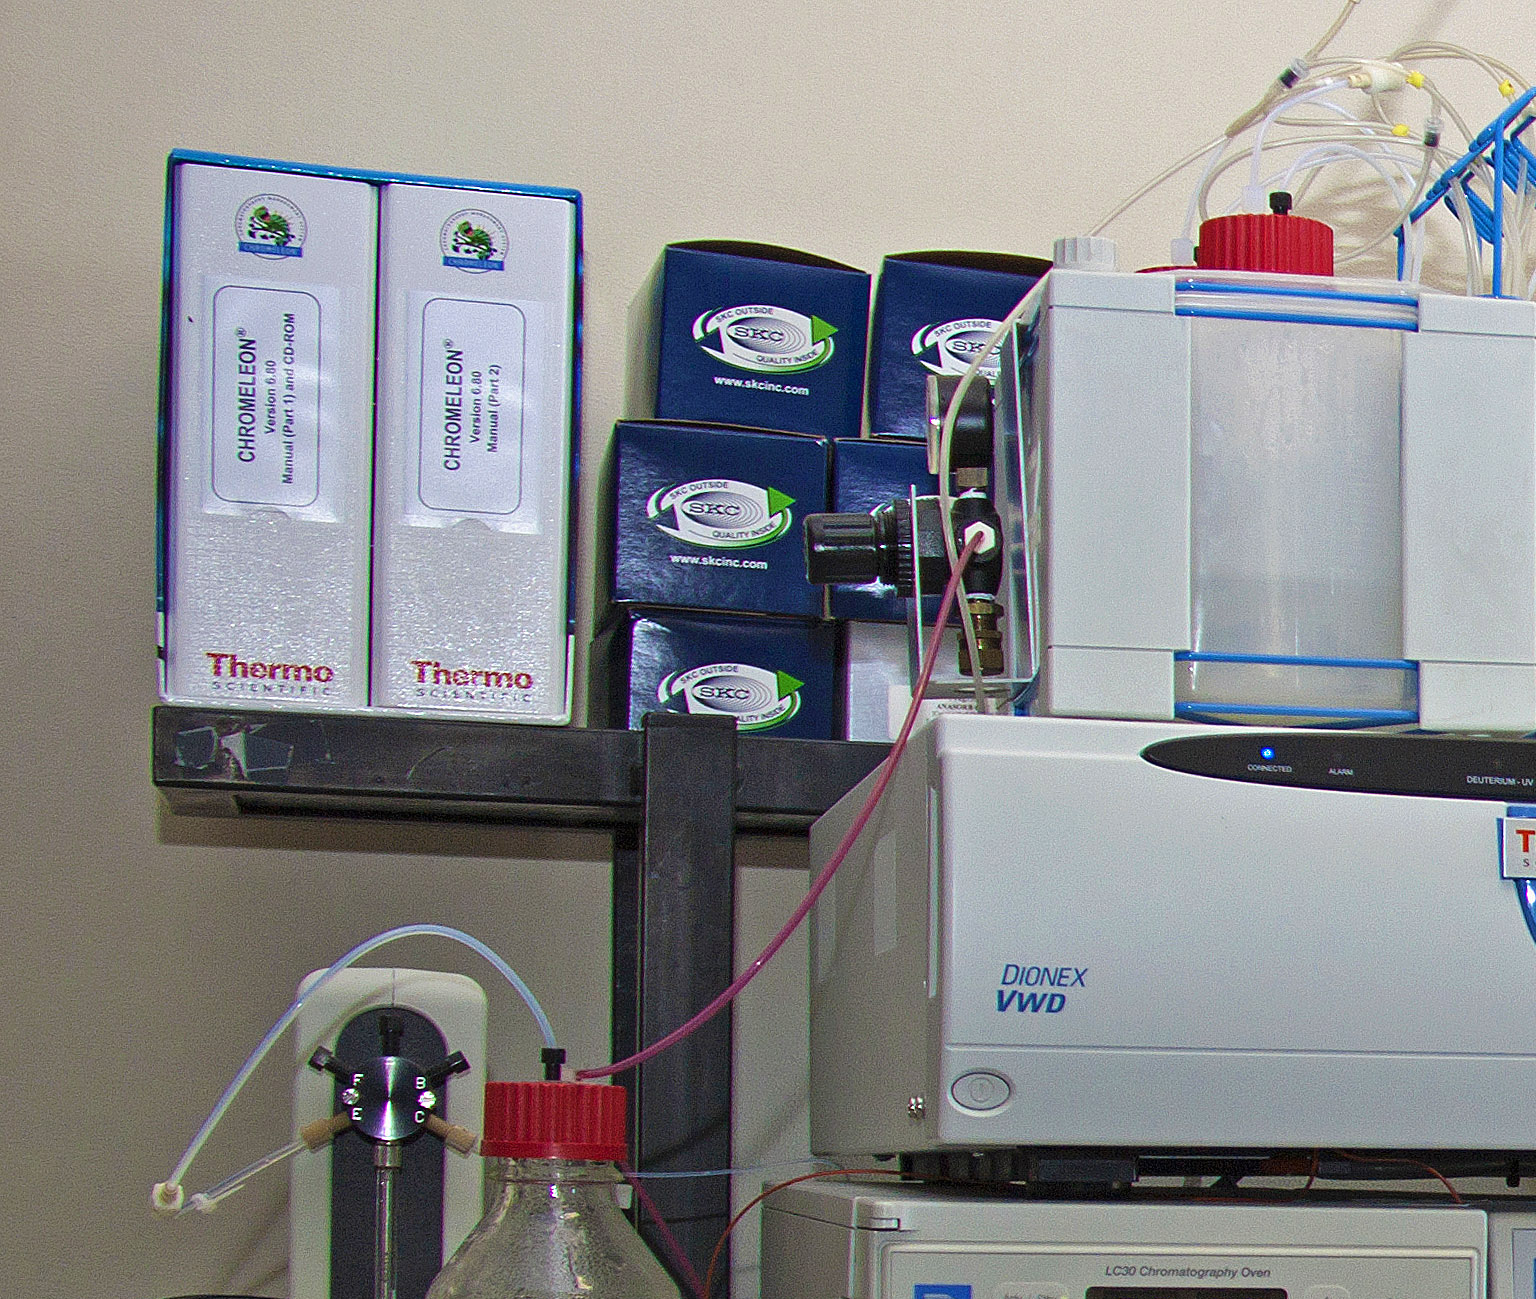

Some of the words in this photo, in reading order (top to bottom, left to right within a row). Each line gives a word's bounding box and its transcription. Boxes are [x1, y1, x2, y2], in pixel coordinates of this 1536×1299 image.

[736, 307, 774, 315] OUTSIDE
[283, 313, 295, 364] CD-ROM
[734, 326, 784, 342] SKC
[756, 354, 791, 364] QUALITY
[488, 365, 501, 376] 2)
[283, 369, 294, 391] and
[714, 376, 809, 395] www.skcinc.com
[283, 395, 296, 405] 1)
[488, 379, 501, 407] (Part
[264, 389, 276, 434] Version
[283, 409, 296, 437] (Part
[469, 399, 481, 443] Version
[487, 410, 499, 453] Manual
[282, 441, 294, 484] Manual
[670, 487, 688, 499] SKC
[691, 482, 728, 492] OUTSIDE
[689, 503, 740, 515] SKC
[712, 530, 749, 538] QUALITY
[669, 554, 768, 570] www.skcinc.com
[205, 652, 334, 683] Thermo
[410, 660, 533, 689] Thermo
[681, 670, 698, 683] SKC
[700, 665, 738, 674] OUTSIDE
[212, 681, 331, 696] SCIENTIFIC
[416, 688, 533, 702] SCIENTIFIC
[698, 686, 749, 700] SKC
[1248, 764, 1292, 773] CONNECTED
[1466, 775, 1516, 785] DEUTERIUM
[1521, 778, 1533, 786] UV
[996, 989, 1066, 1013] VWD
[1106, 1266, 1136, 1277] LC30
[1139, 1266, 1238, 1279] Chromatography
[1241, 1268, 1271, 1278] Oven
